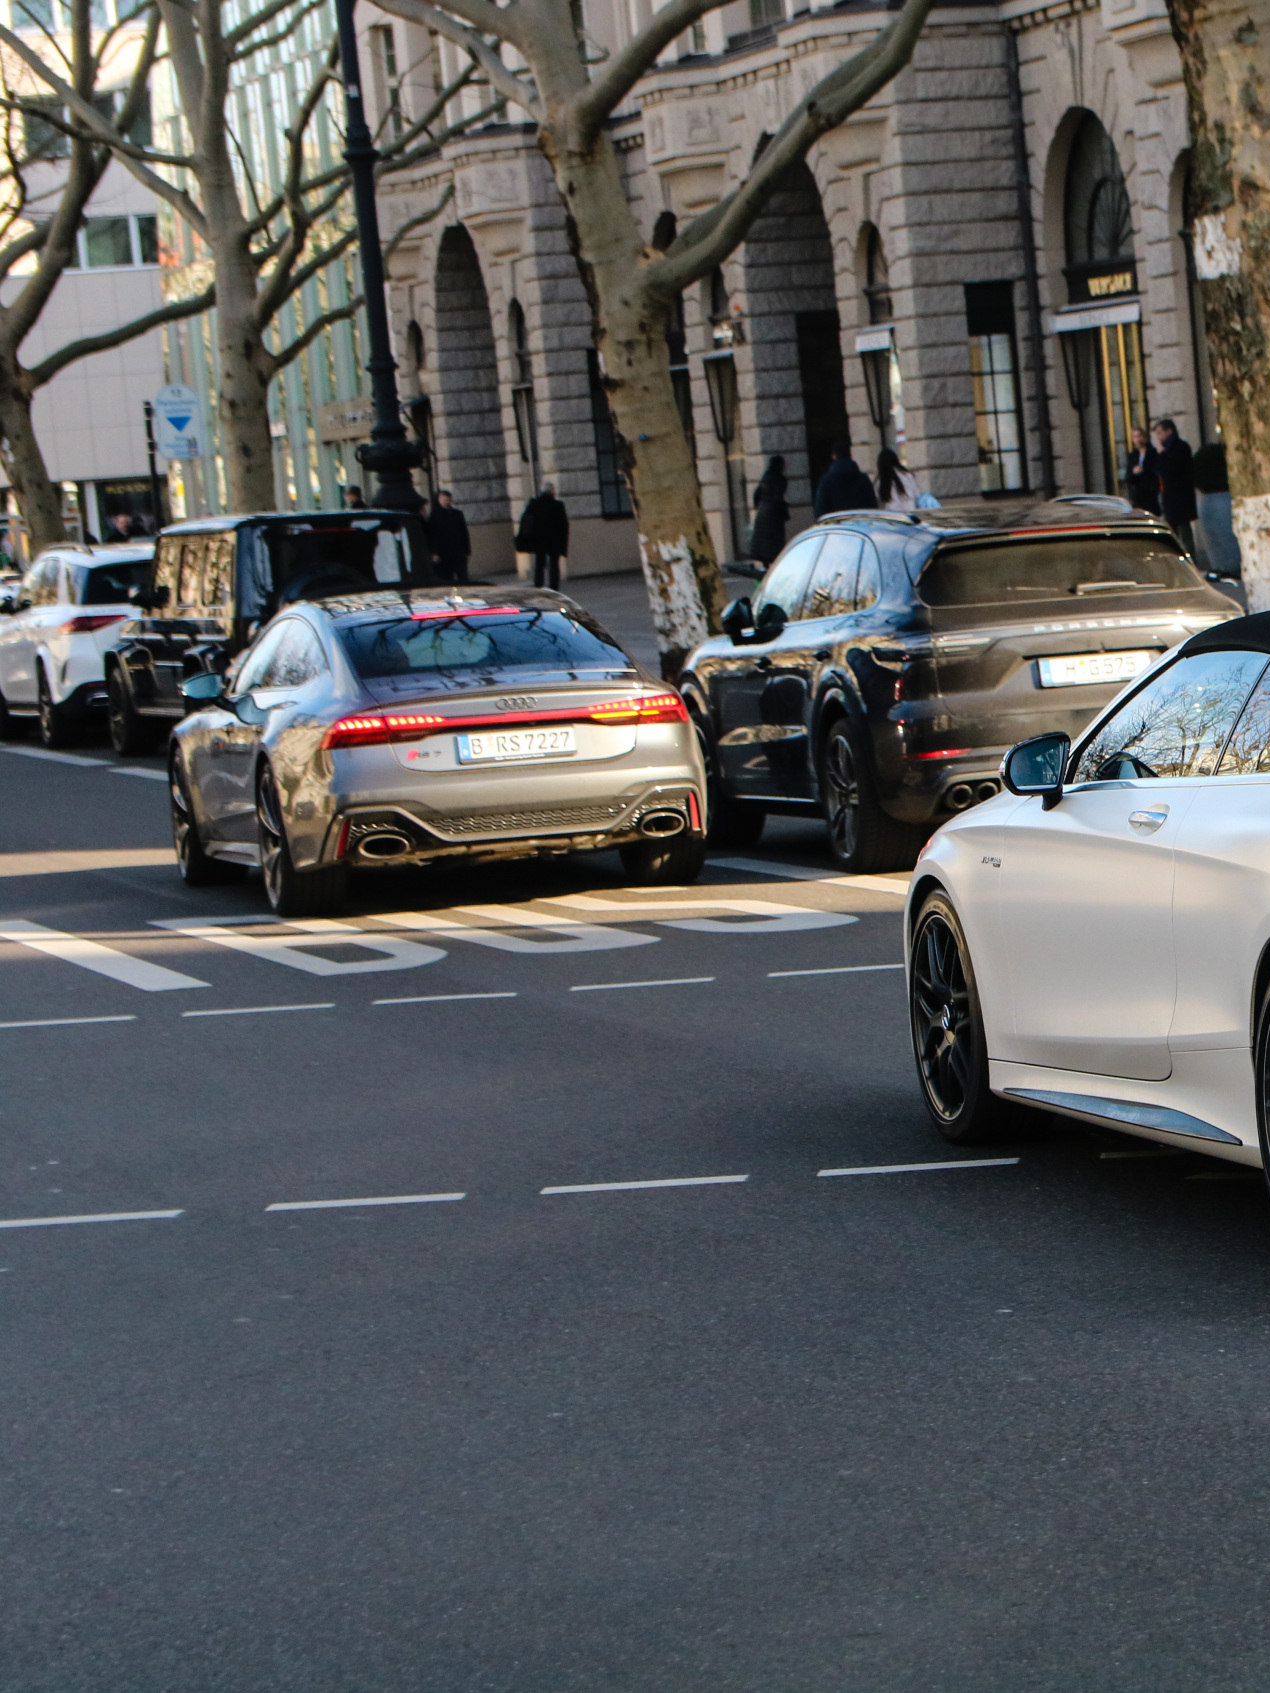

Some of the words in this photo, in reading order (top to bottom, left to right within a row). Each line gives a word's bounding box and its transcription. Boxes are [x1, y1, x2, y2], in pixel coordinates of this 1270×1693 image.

[1065, 661, 1076, 677] H
[1089, 659, 1100, 676] G
[1103, 656, 1136, 675] 575
[471, 738, 483, 755] B
[496, 734, 520, 753] RS
[525, 731, 570, 751] 7227
